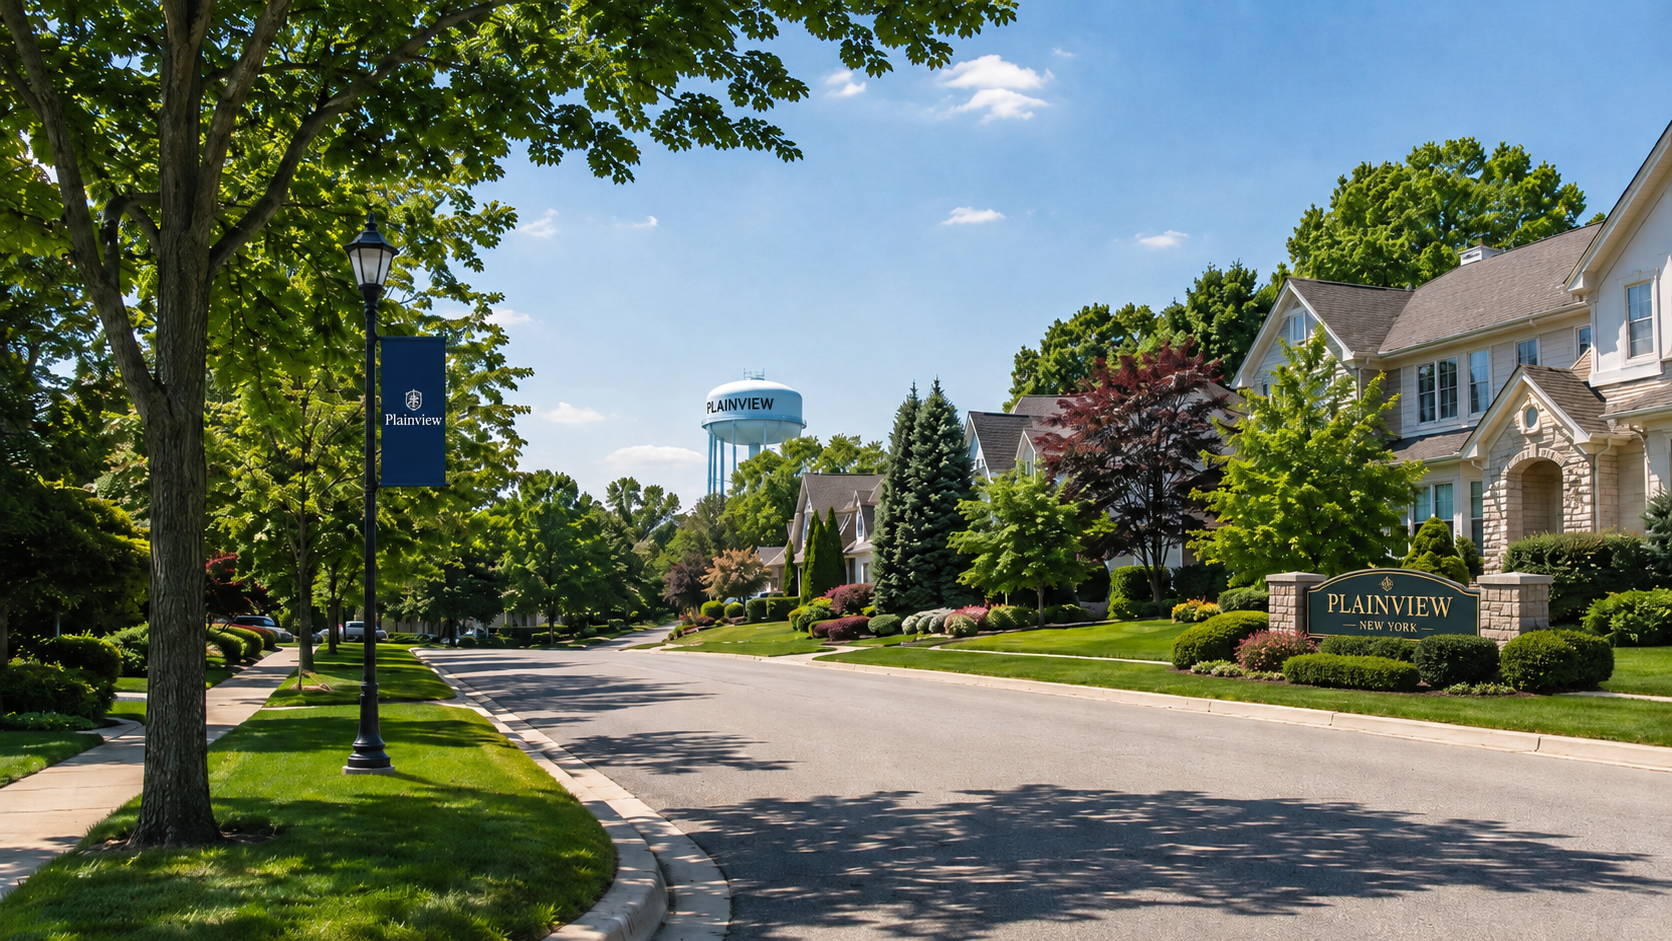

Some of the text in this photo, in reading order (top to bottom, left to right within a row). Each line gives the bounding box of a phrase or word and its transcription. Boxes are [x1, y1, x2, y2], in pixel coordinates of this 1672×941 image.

[706, 397, 775, 414] PLAINVIEW
[385, 413, 442, 426] Plainview
[1327, 593, 1453, 618] PLAINVIEW
[1359, 620, 1418, 633] NEW YORK
